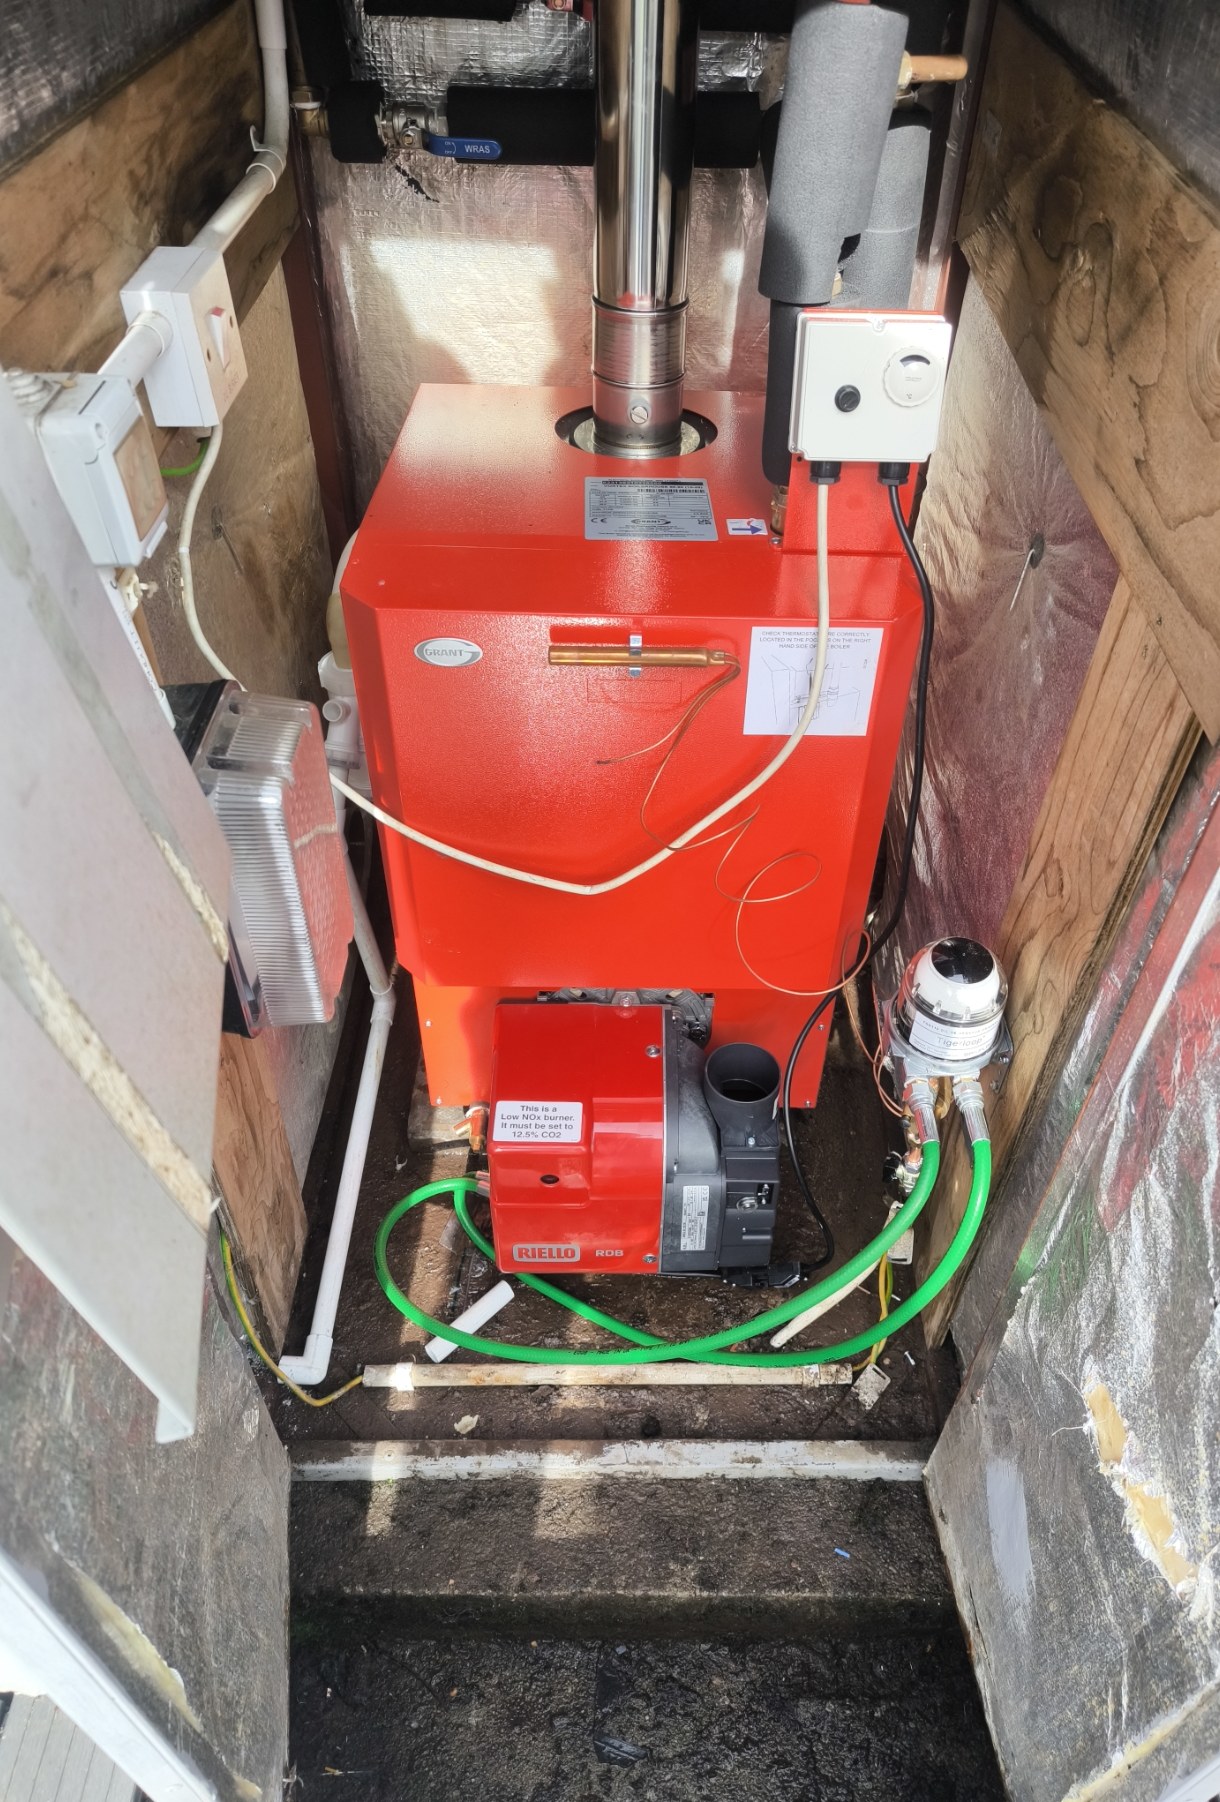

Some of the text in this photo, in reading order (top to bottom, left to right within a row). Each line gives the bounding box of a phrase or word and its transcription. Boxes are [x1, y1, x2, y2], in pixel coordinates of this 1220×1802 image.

[464, 145, 490, 154] WRAS
[424, 648, 464, 657] GRANT
[543, 1114, 575, 1122] burner.
[517, 1247, 624, 1259] RIELLO RDB
